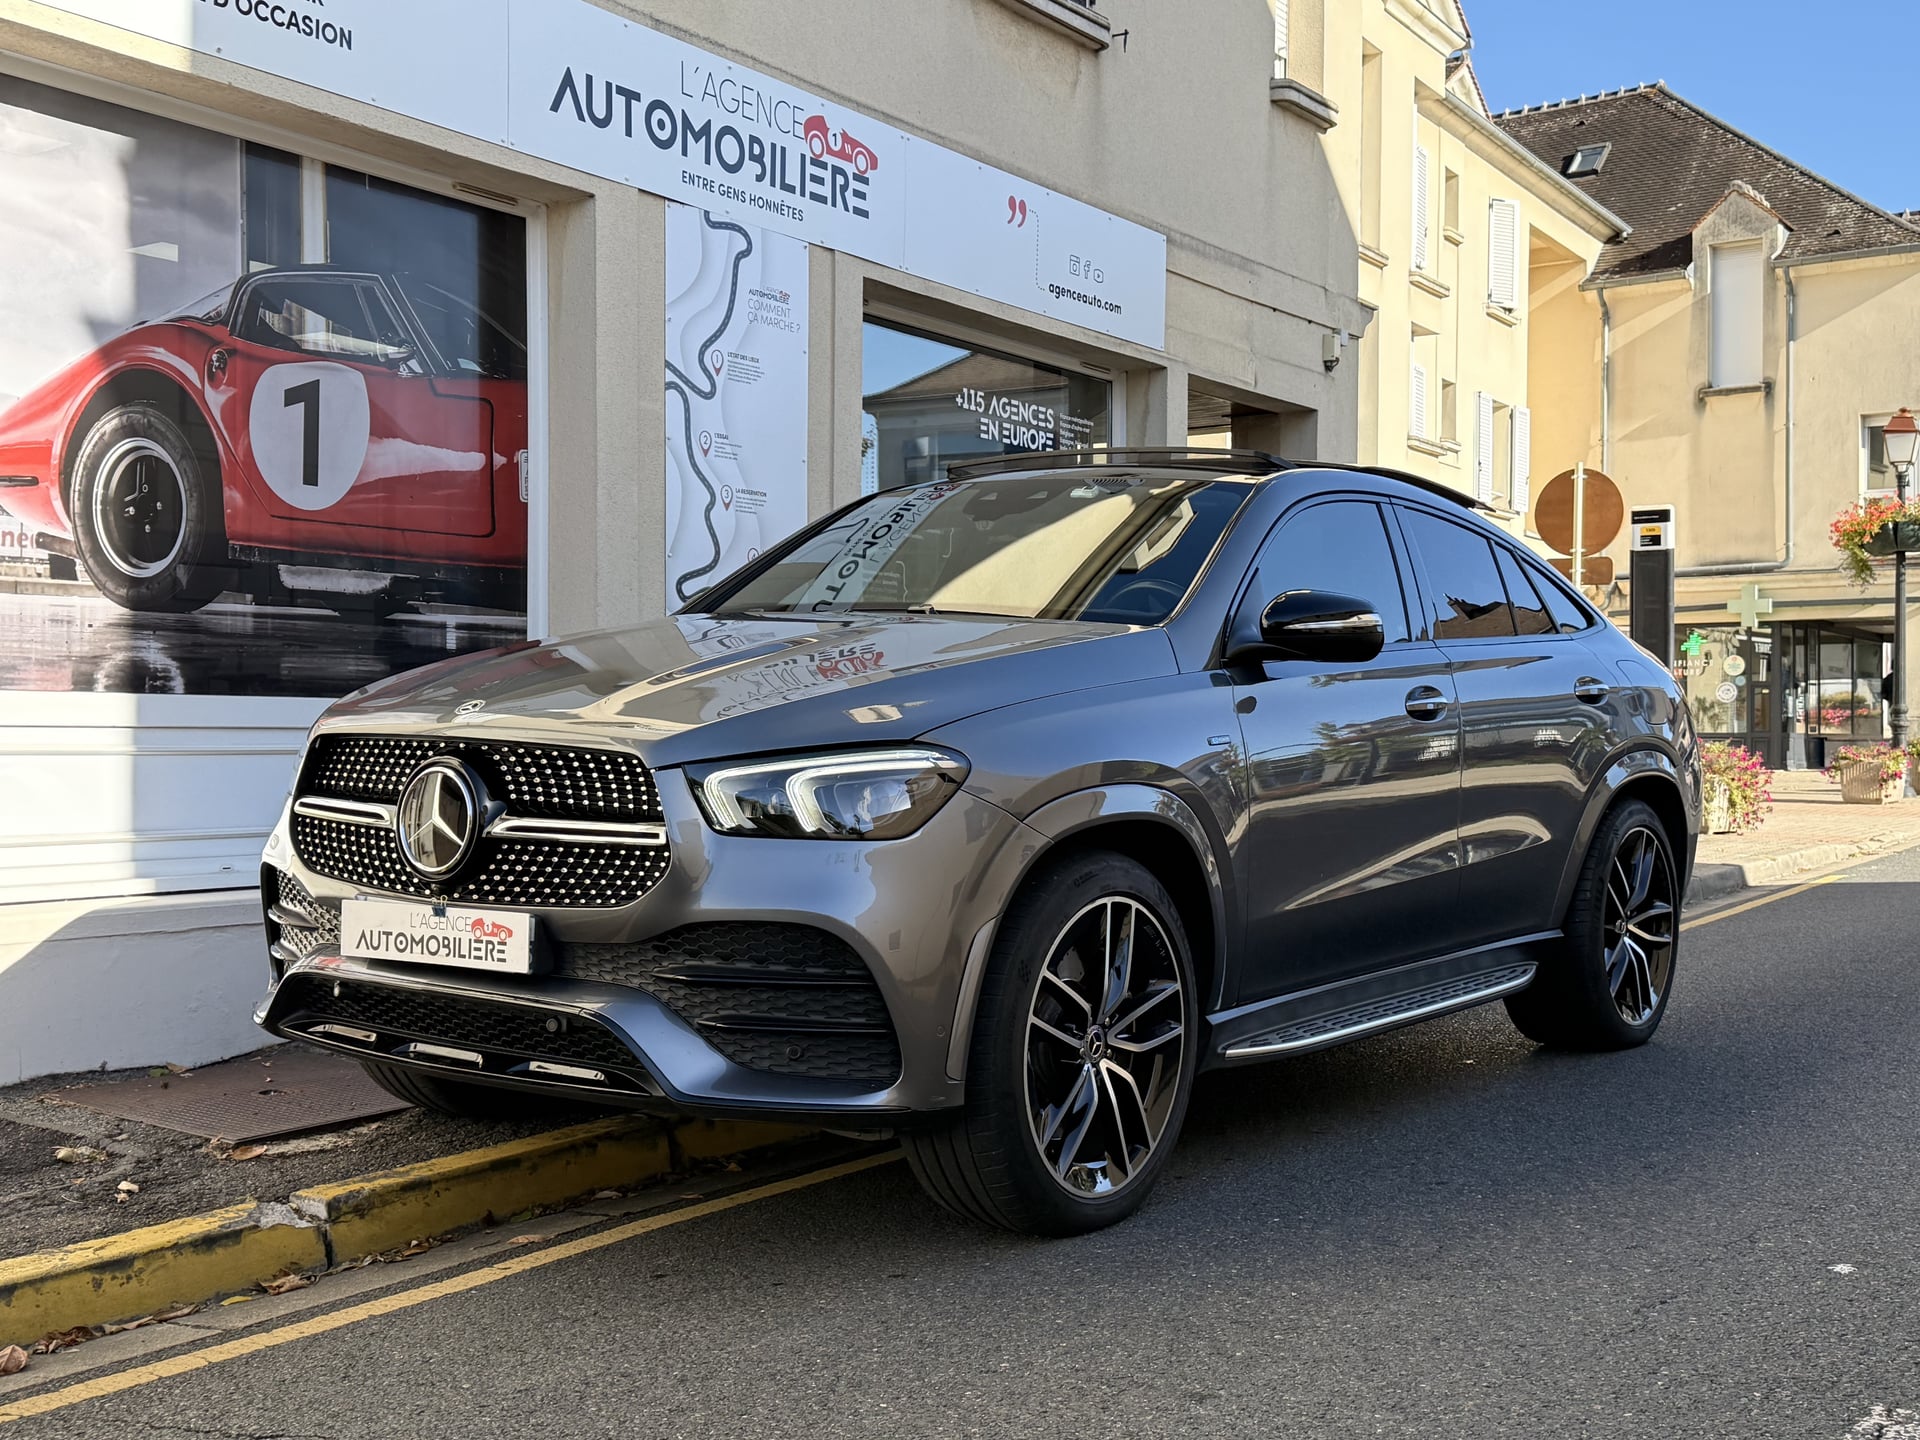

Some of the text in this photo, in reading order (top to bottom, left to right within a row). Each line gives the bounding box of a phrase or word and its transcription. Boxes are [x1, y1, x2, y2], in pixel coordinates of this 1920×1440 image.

[680, 60, 805, 140] L'AGENCE
[682, 170, 804, 222] ENTRE GENS HONNÊTES
[748, 298, 791, 318] COMMENT
[1049, 283, 1122, 315] agenceauto.com
[748, 311, 759, 324] ÇA
[761, 315, 795, 333] MARCHE
[956, 388, 1054, 429] +115 AGENCES
[284, 379, 320, 487] 1
[980, 417, 999, 441] EN
[1002, 422, 1054, 451] EUROPE
[410, 912, 472, 933] L'AGENCE
